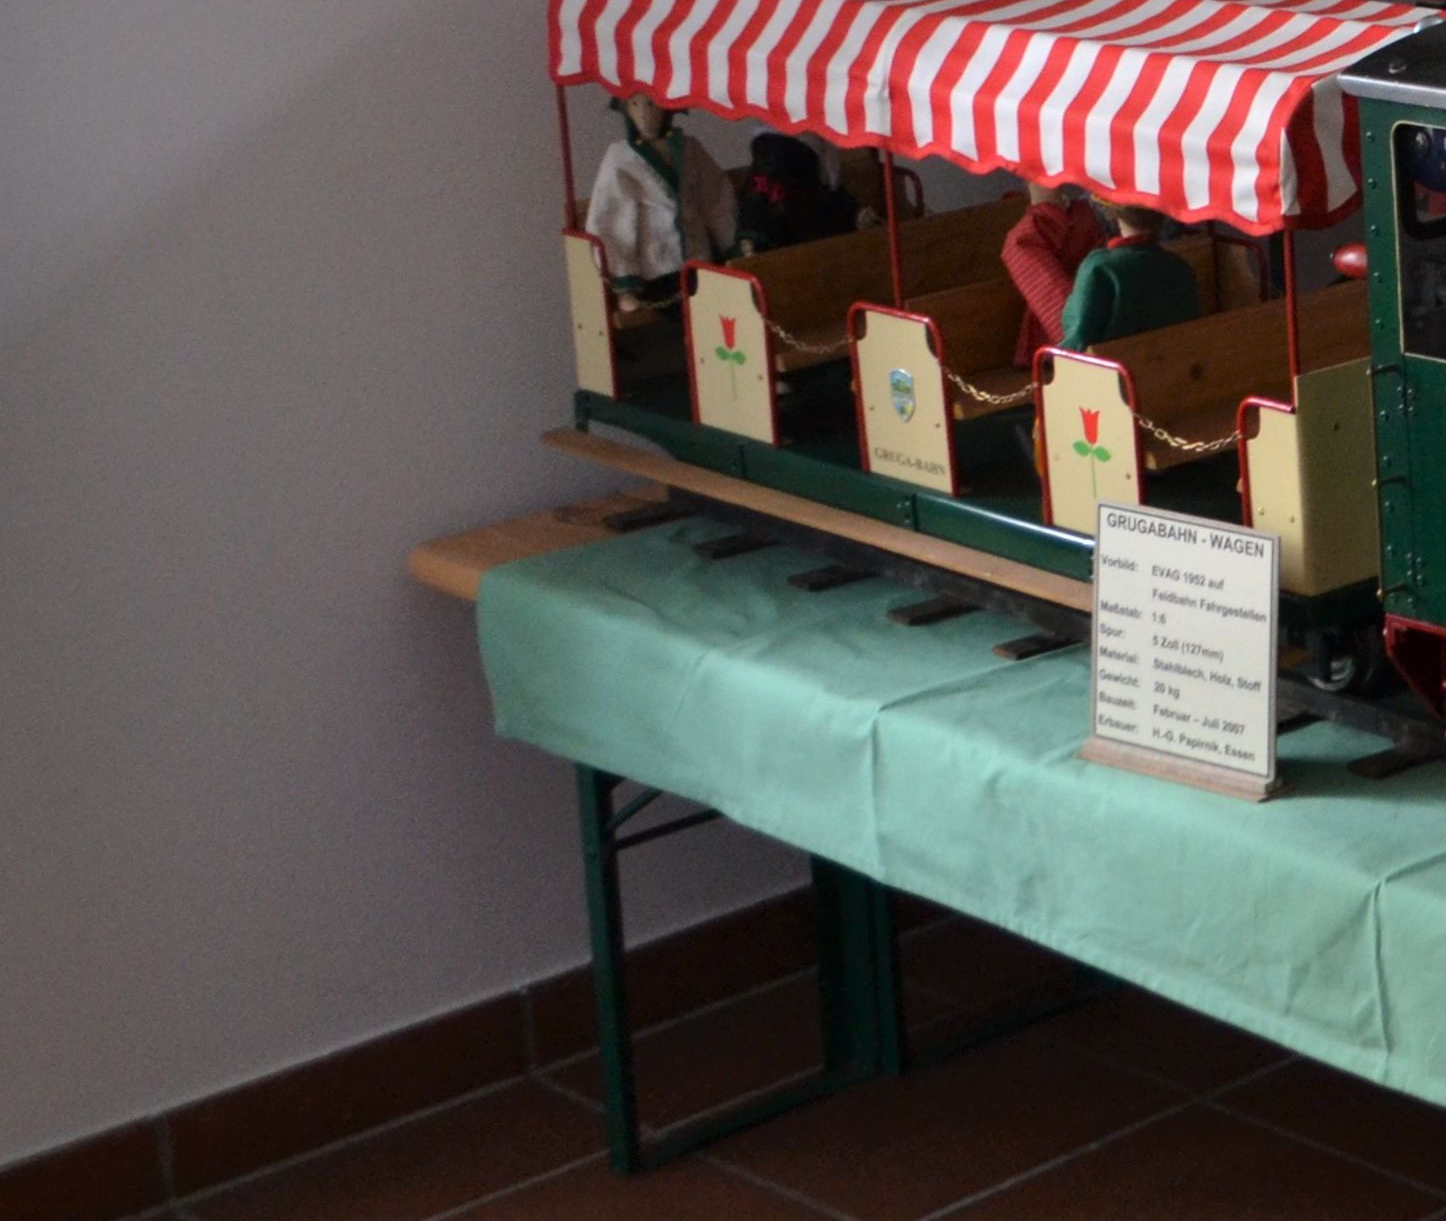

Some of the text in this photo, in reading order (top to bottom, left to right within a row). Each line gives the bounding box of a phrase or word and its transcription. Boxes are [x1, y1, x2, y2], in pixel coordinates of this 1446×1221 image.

[1106, 513, 1198, 544] GRUGABAHN
[1209, 534, 1265, 558] WAGEN
[1101, 554, 1139, 572] Vorbild:
[1152, 565, 1180, 582] EVAG
[1208, 577, 1225, 590] auf
[1152, 588, 1197, 609] Feldbahn
[1160, 637, 1179, 651] Zoll
[1181, 641, 1224, 663] (127mm)
[1099, 646, 1140, 665] Material:
[1237, 676, 1262, 693] Stoff
[1167, 684, 1181, 700] kg
[1202, 717, 1220, 731] Juli
[1224, 744, 1256, 762] Essen
